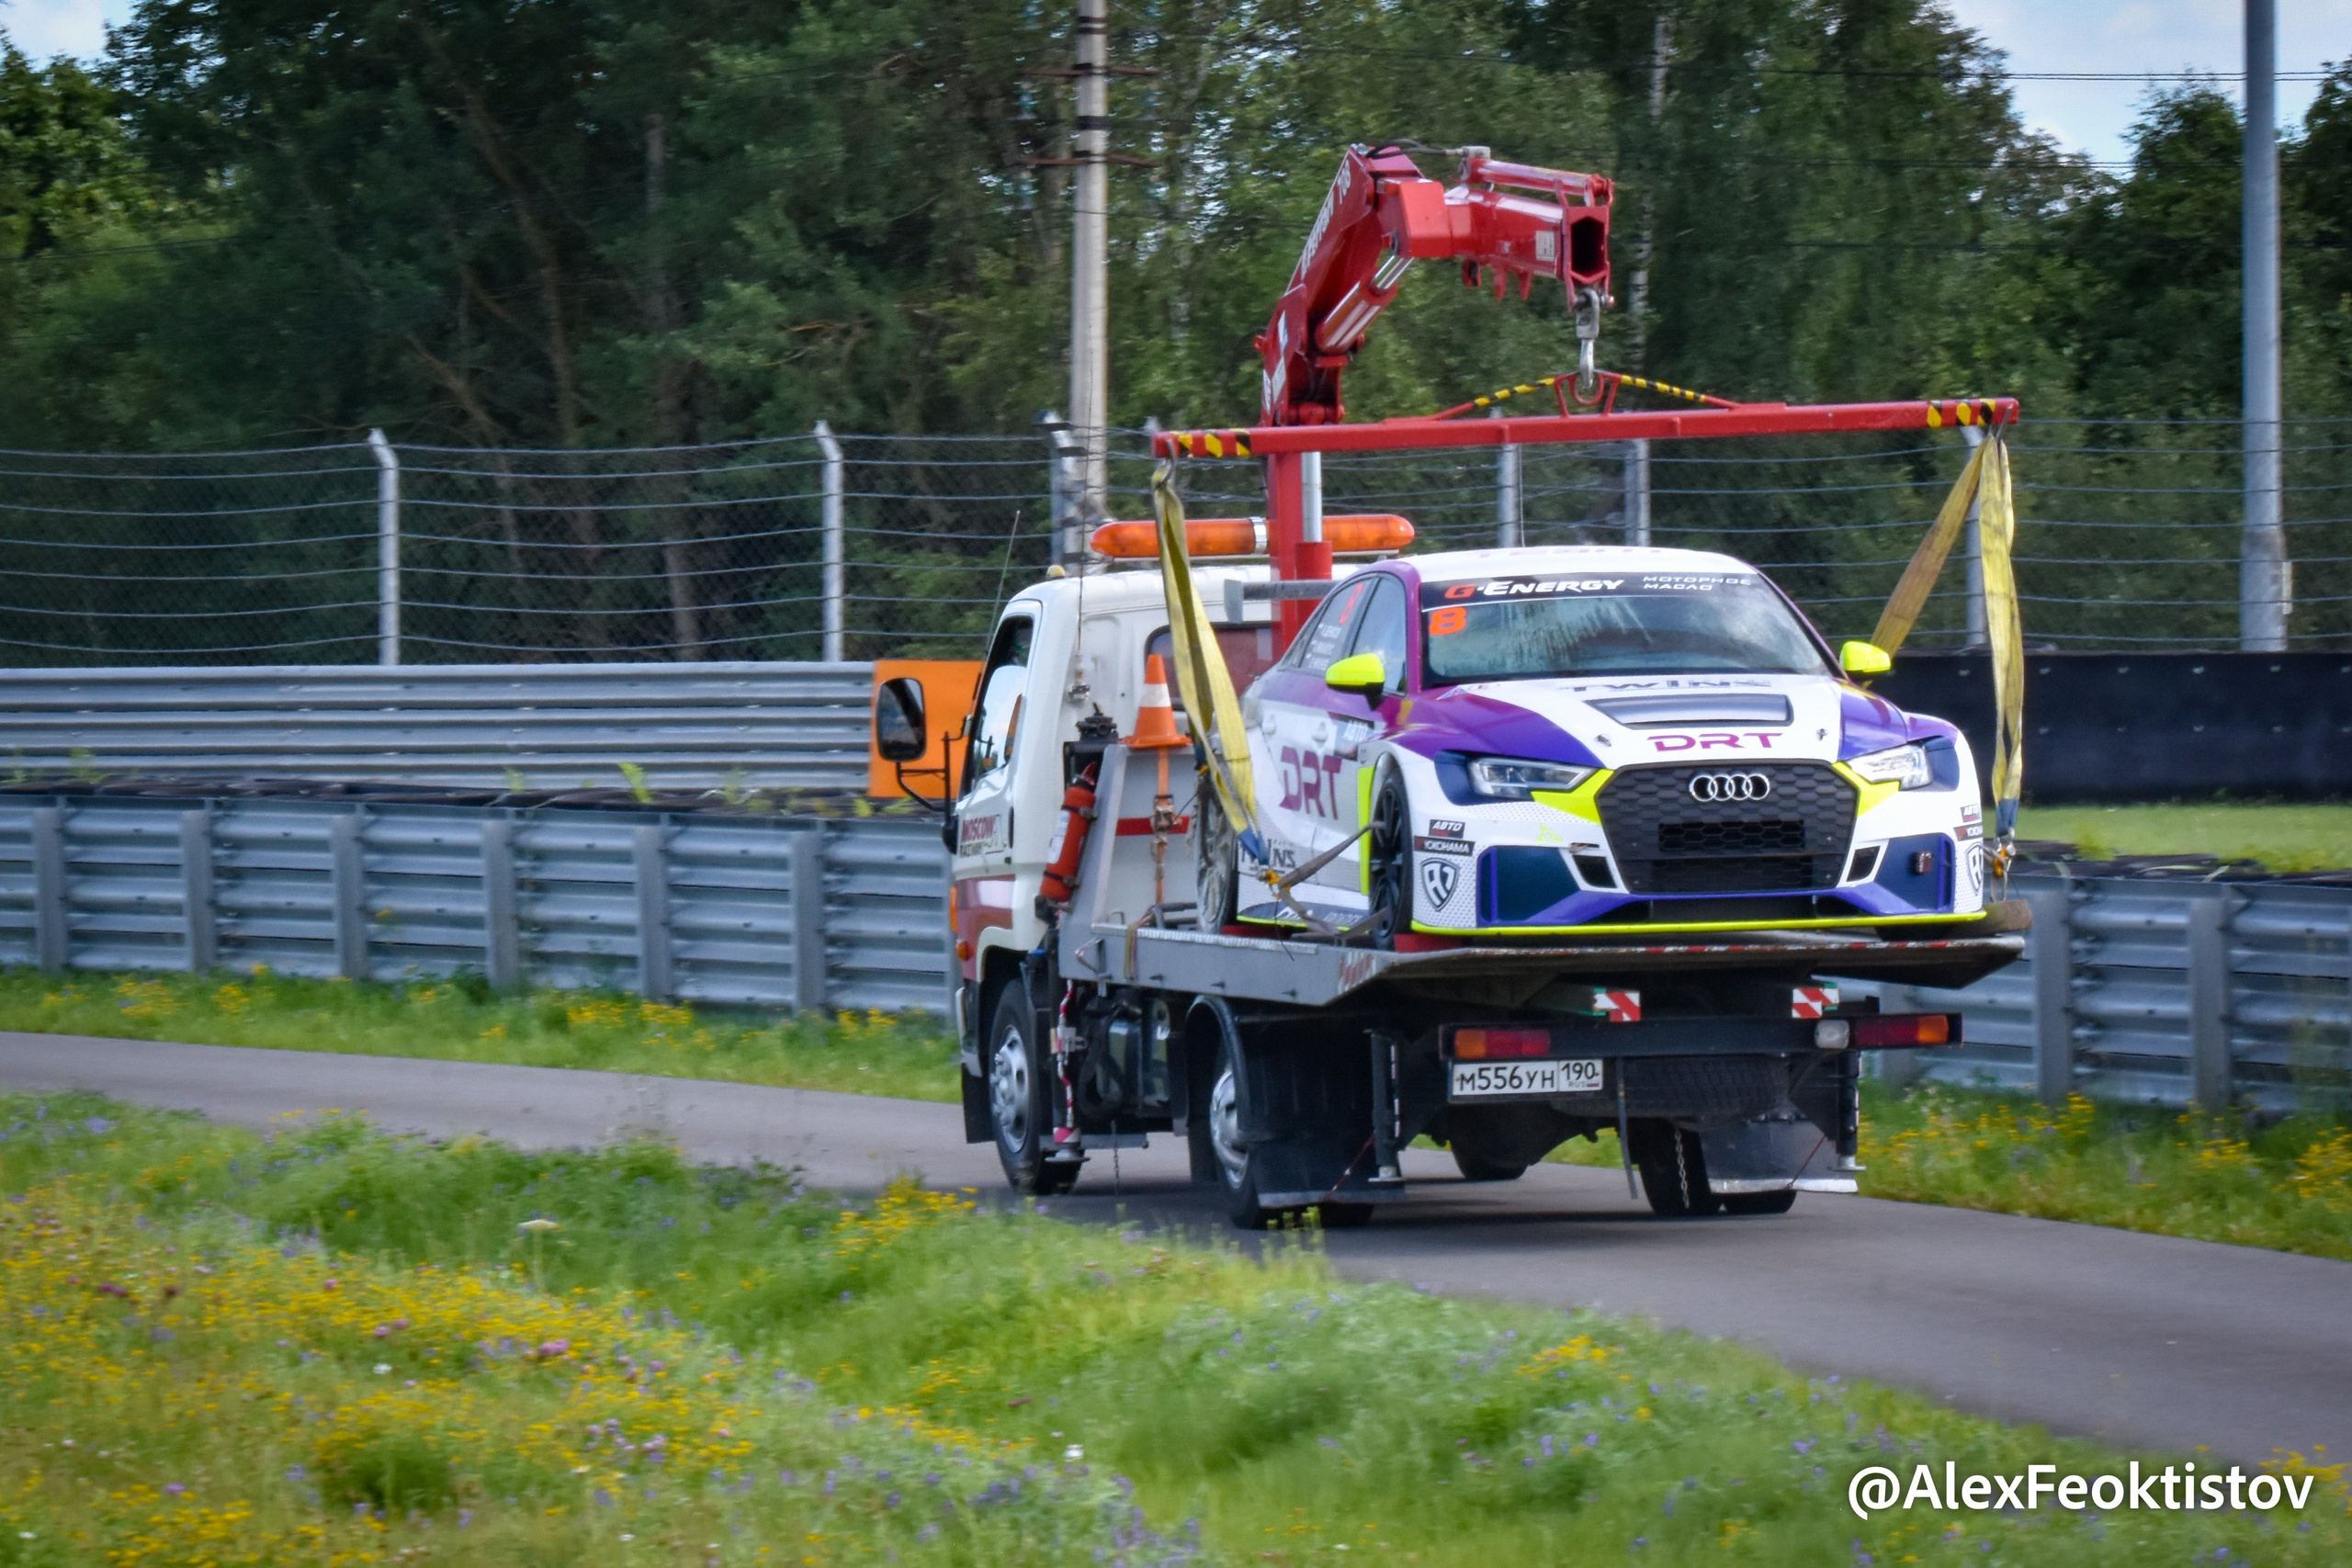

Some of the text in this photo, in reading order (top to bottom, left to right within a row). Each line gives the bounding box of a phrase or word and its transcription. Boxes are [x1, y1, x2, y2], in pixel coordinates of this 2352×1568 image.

[1643, 576, 1751, 586] МОТОРНОЕ
[1429, 606, 1467, 636] 8
[1646, 732, 1784, 752] DRT
[1279, 746, 1343, 820] DRT
[1423, 840, 1470, 854] YOKOHAMA
[1561, 1061, 1597, 1081] 190
[1568, 1080, 1588, 1089] RUS
